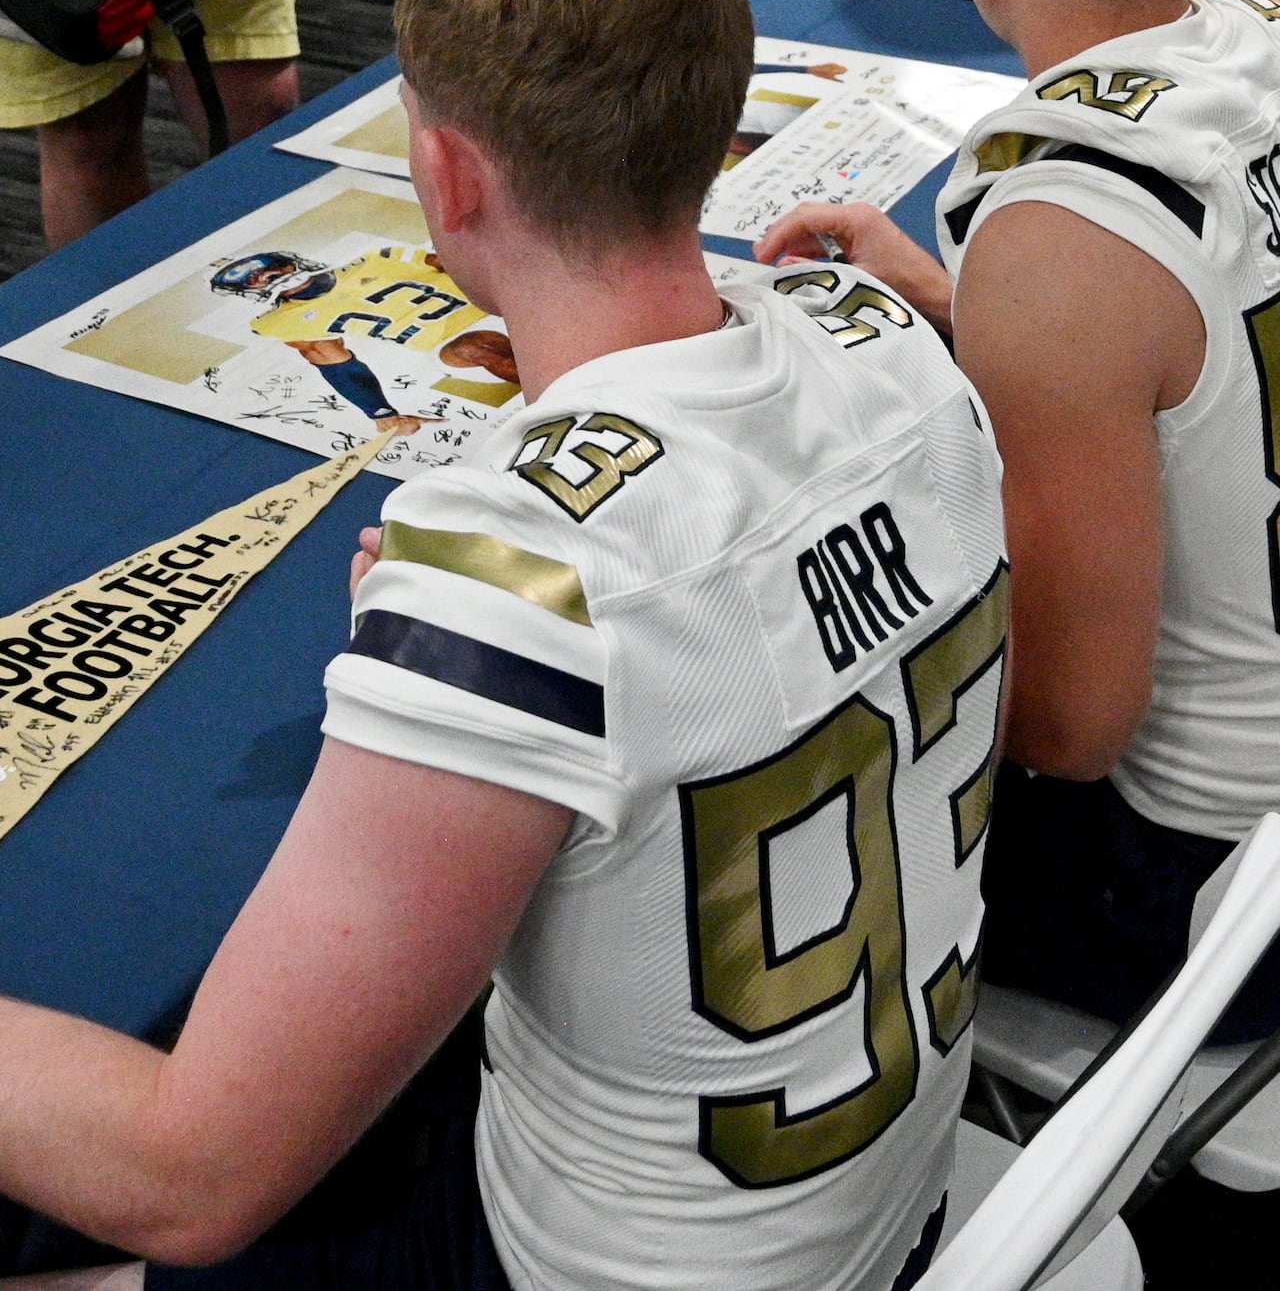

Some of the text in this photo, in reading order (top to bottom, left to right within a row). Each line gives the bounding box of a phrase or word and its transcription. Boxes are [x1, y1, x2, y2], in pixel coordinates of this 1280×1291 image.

[99, 532, 242, 599] TECH.
[796, 501, 933, 674] BIRR
[12, 572, 236, 724] FOOTBALL
[678, 558, 1011, 1190] 93
